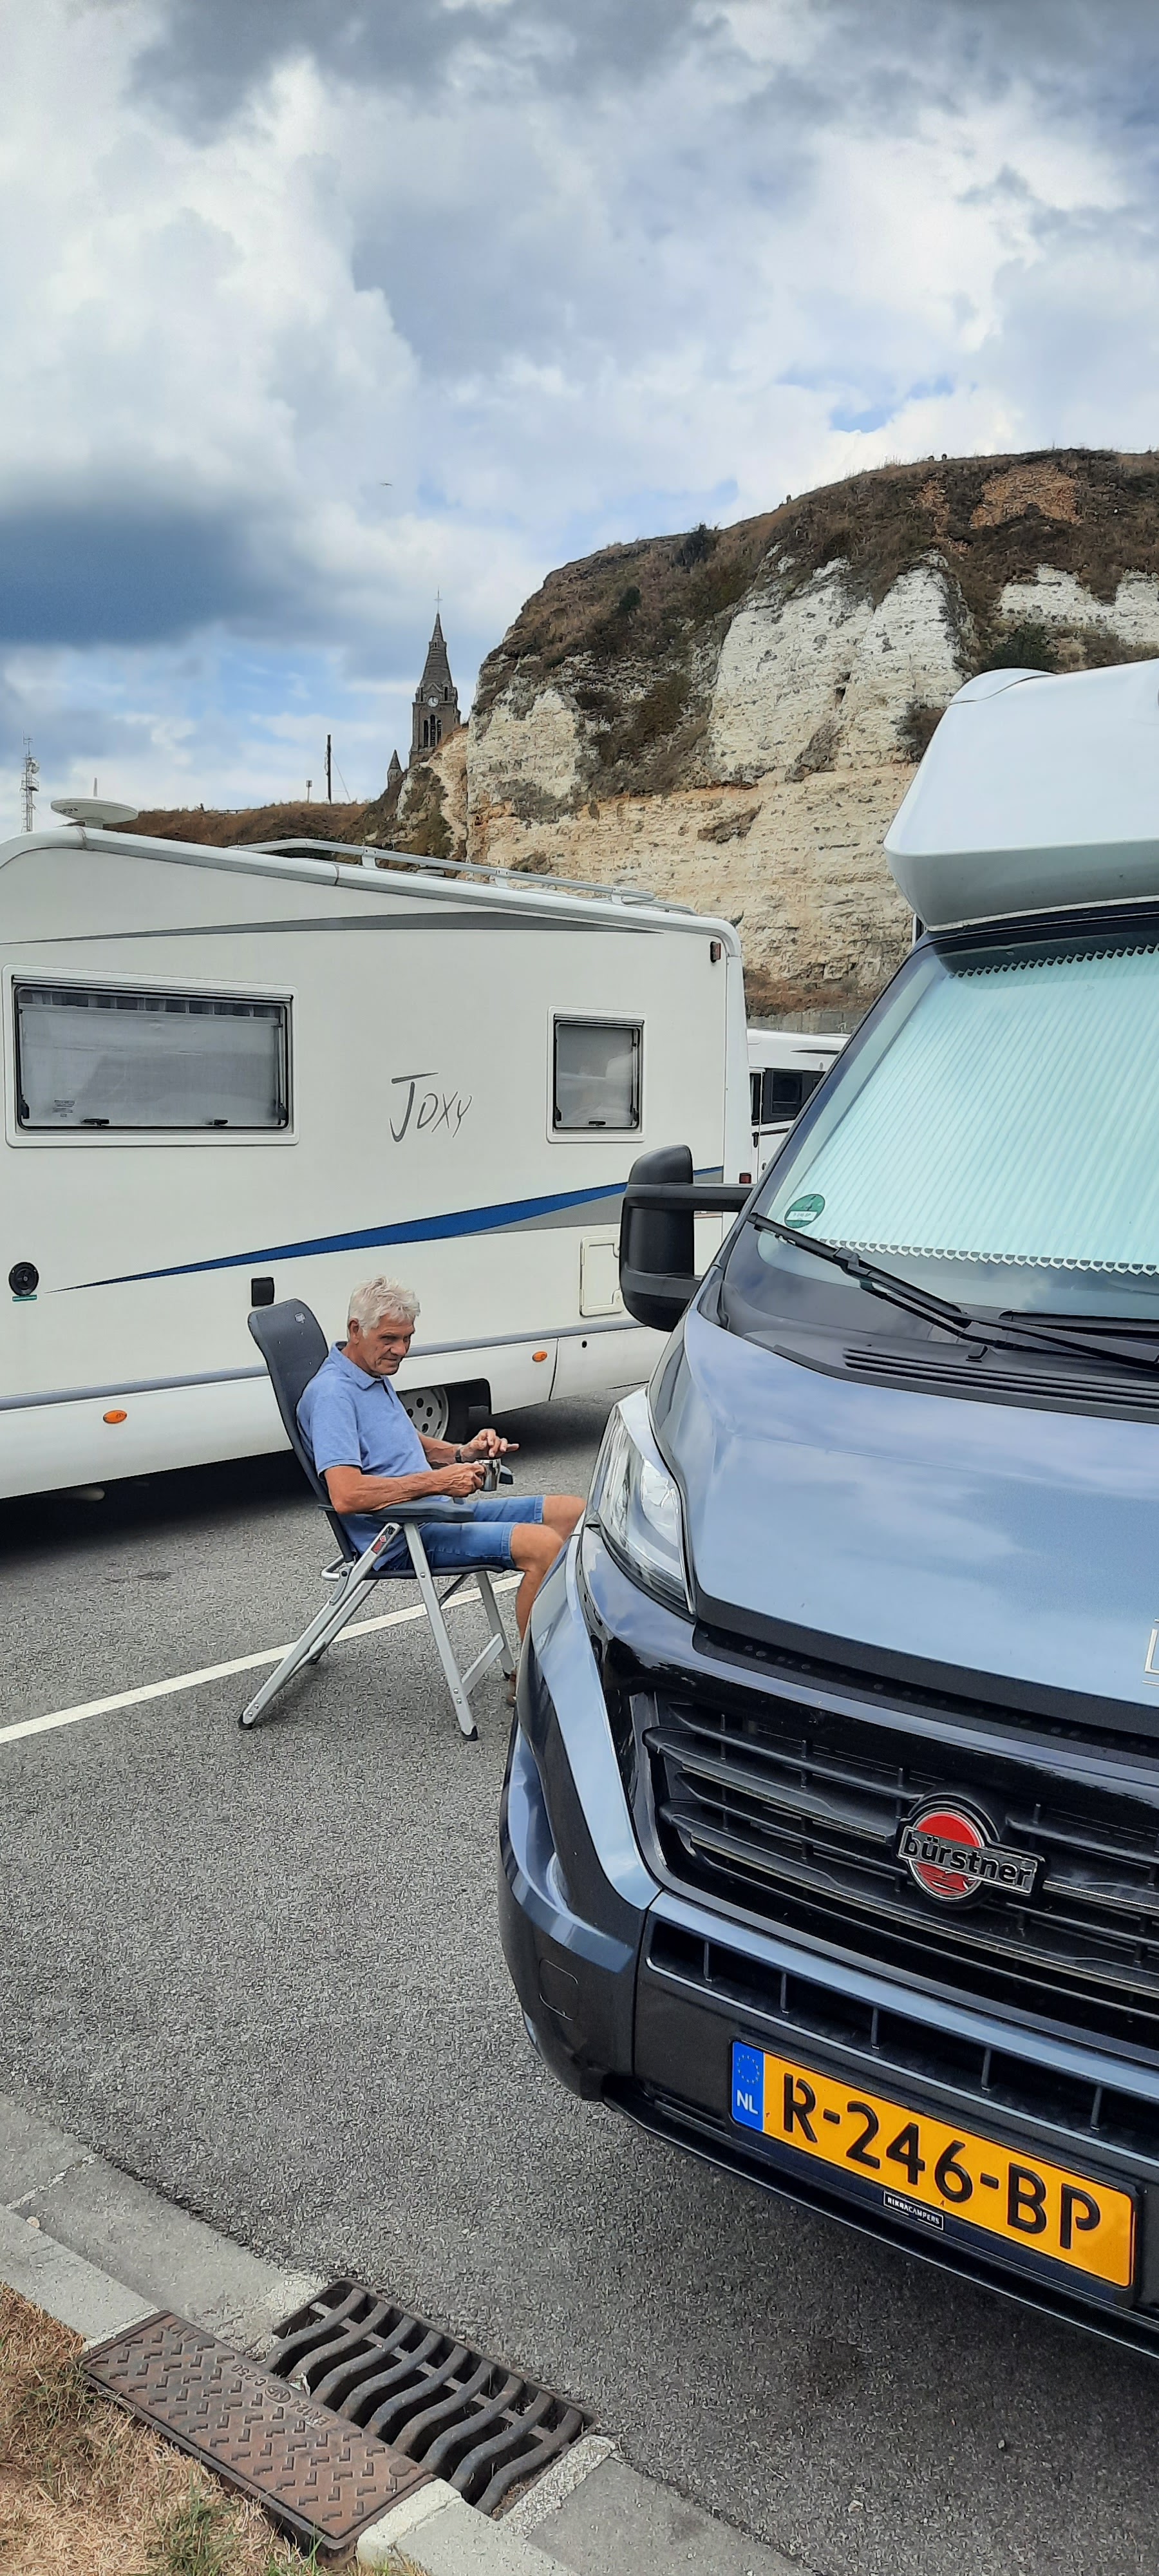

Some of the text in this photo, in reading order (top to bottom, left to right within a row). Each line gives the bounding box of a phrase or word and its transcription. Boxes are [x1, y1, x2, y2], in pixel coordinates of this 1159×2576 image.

[903, 1830, 1032, 1888] bürstner
[737, 2088, 759, 2116] NL
[783, 2072, 1101, 2249] R-246-BP
[231, 2363, 258, 2381] 250
